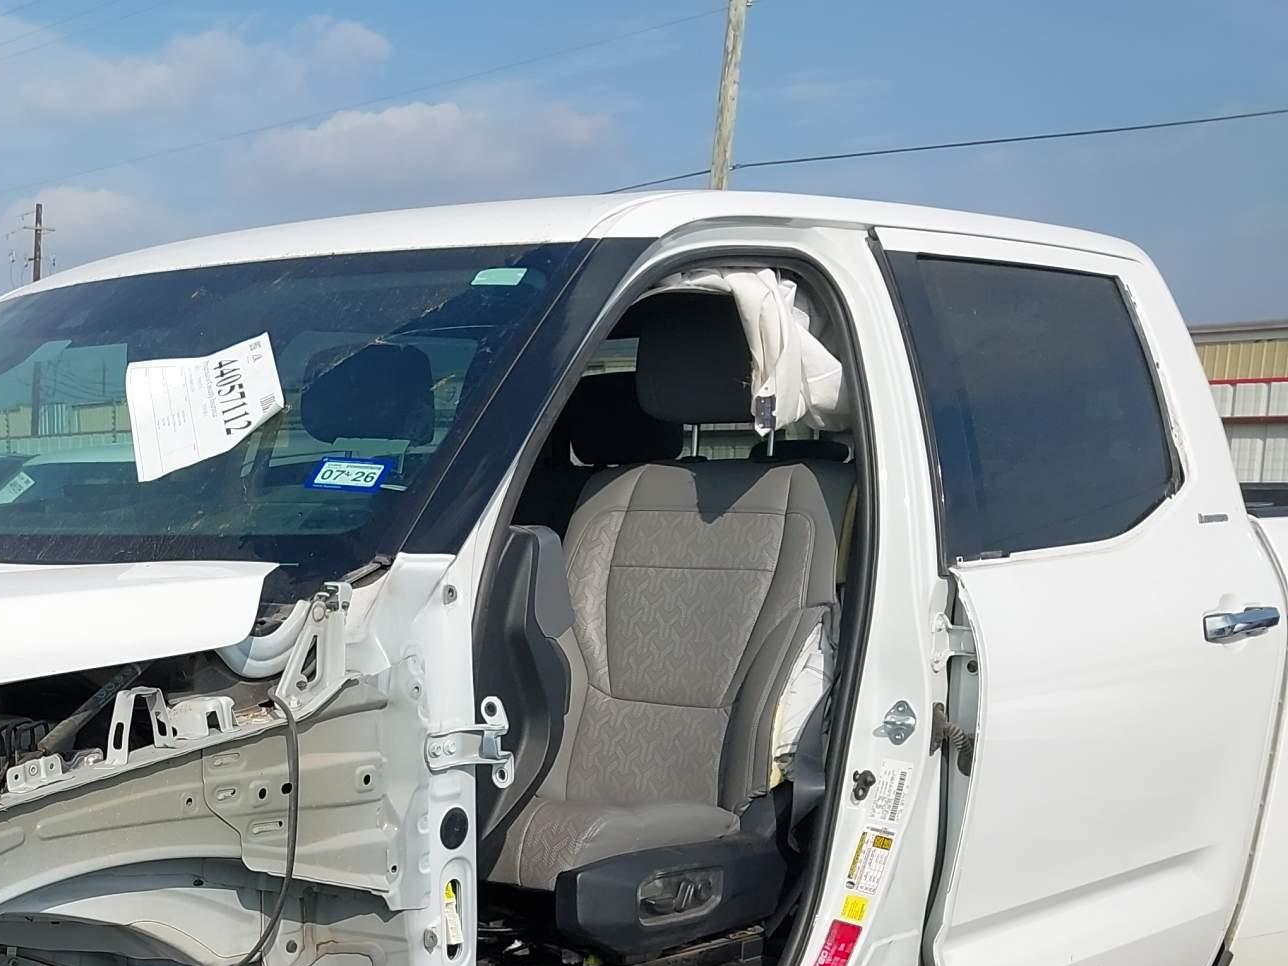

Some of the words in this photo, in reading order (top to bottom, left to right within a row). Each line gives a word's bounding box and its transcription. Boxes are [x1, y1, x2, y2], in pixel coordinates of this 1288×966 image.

[212, 359, 253, 436] 44057112
[320, 468, 346, 481] 07
[350, 470, 378, 483] 26
